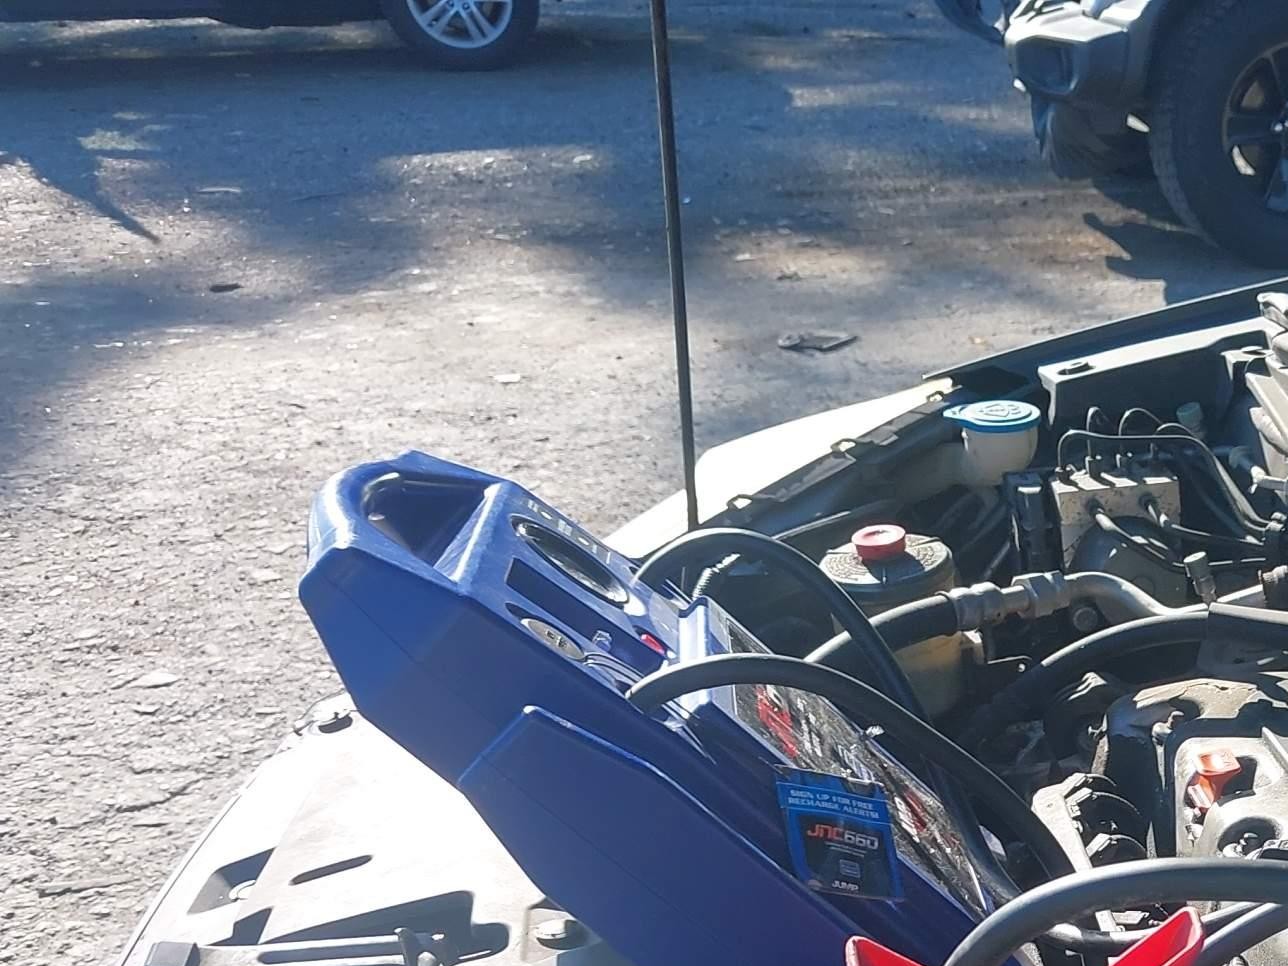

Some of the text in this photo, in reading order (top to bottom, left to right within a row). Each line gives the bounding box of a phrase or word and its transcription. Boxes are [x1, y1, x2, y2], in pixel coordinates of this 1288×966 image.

[788, 797, 840, 810] RECHARGE
[790, 789, 814, 799] SIGN
[833, 795, 850, 806] FOR
[851, 799, 874, 810] FREE
